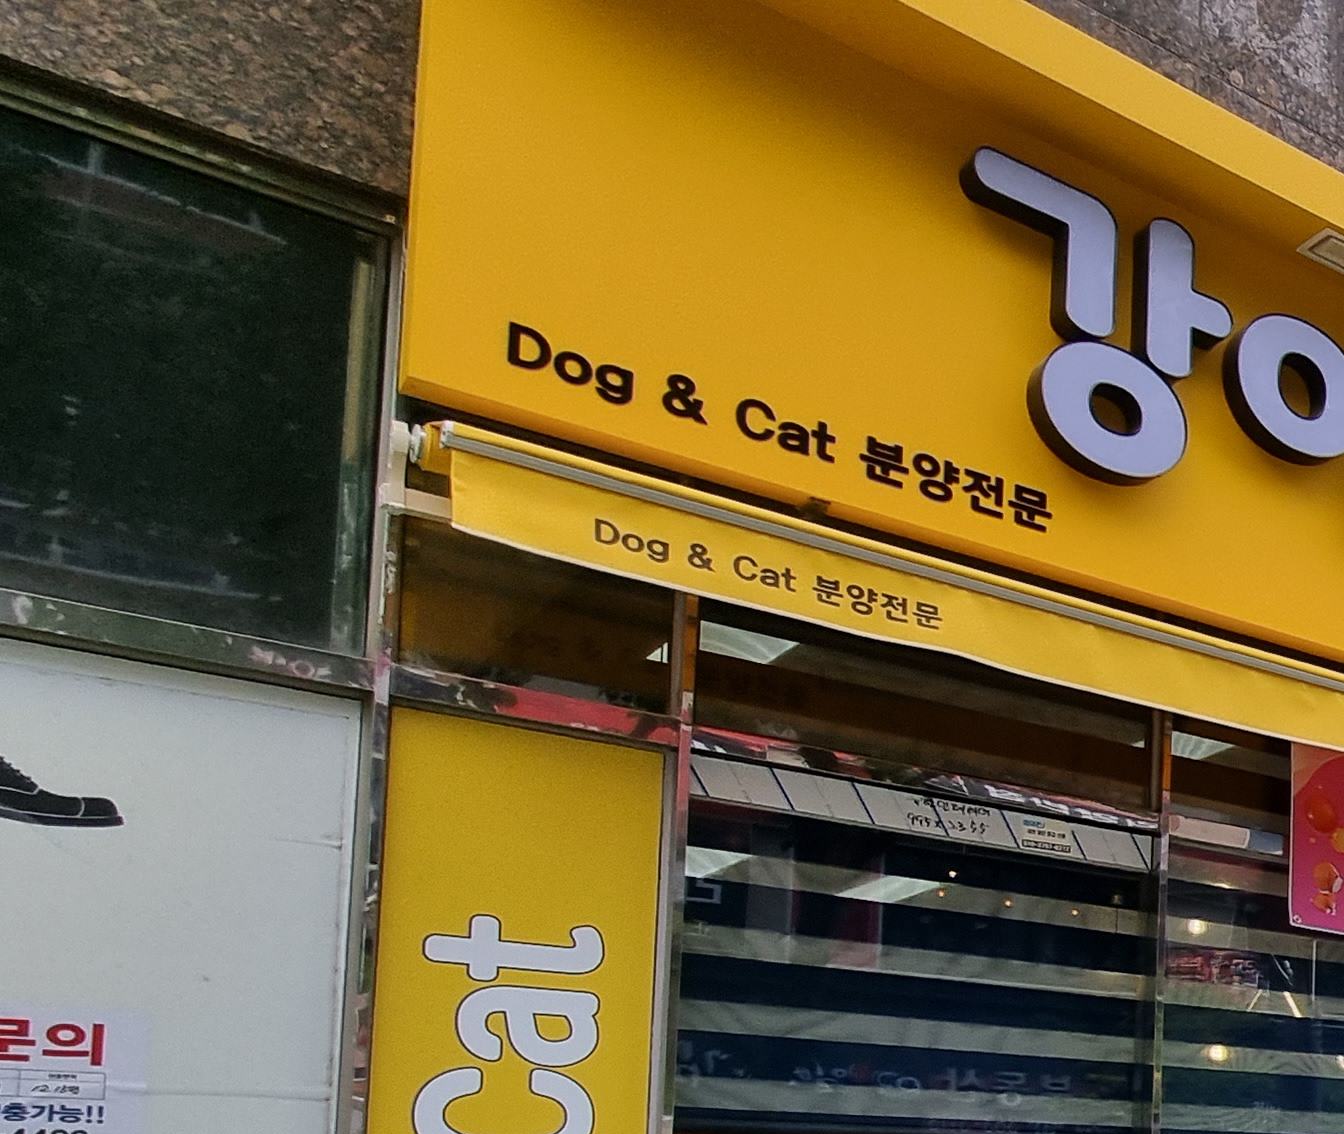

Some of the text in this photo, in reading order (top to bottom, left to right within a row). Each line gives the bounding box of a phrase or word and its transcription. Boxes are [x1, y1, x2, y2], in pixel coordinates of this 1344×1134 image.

[507, 321, 1054, 533] Dog & Cat 분양전문
[593, 517, 943, 630] Dog & Cat 분양전문
